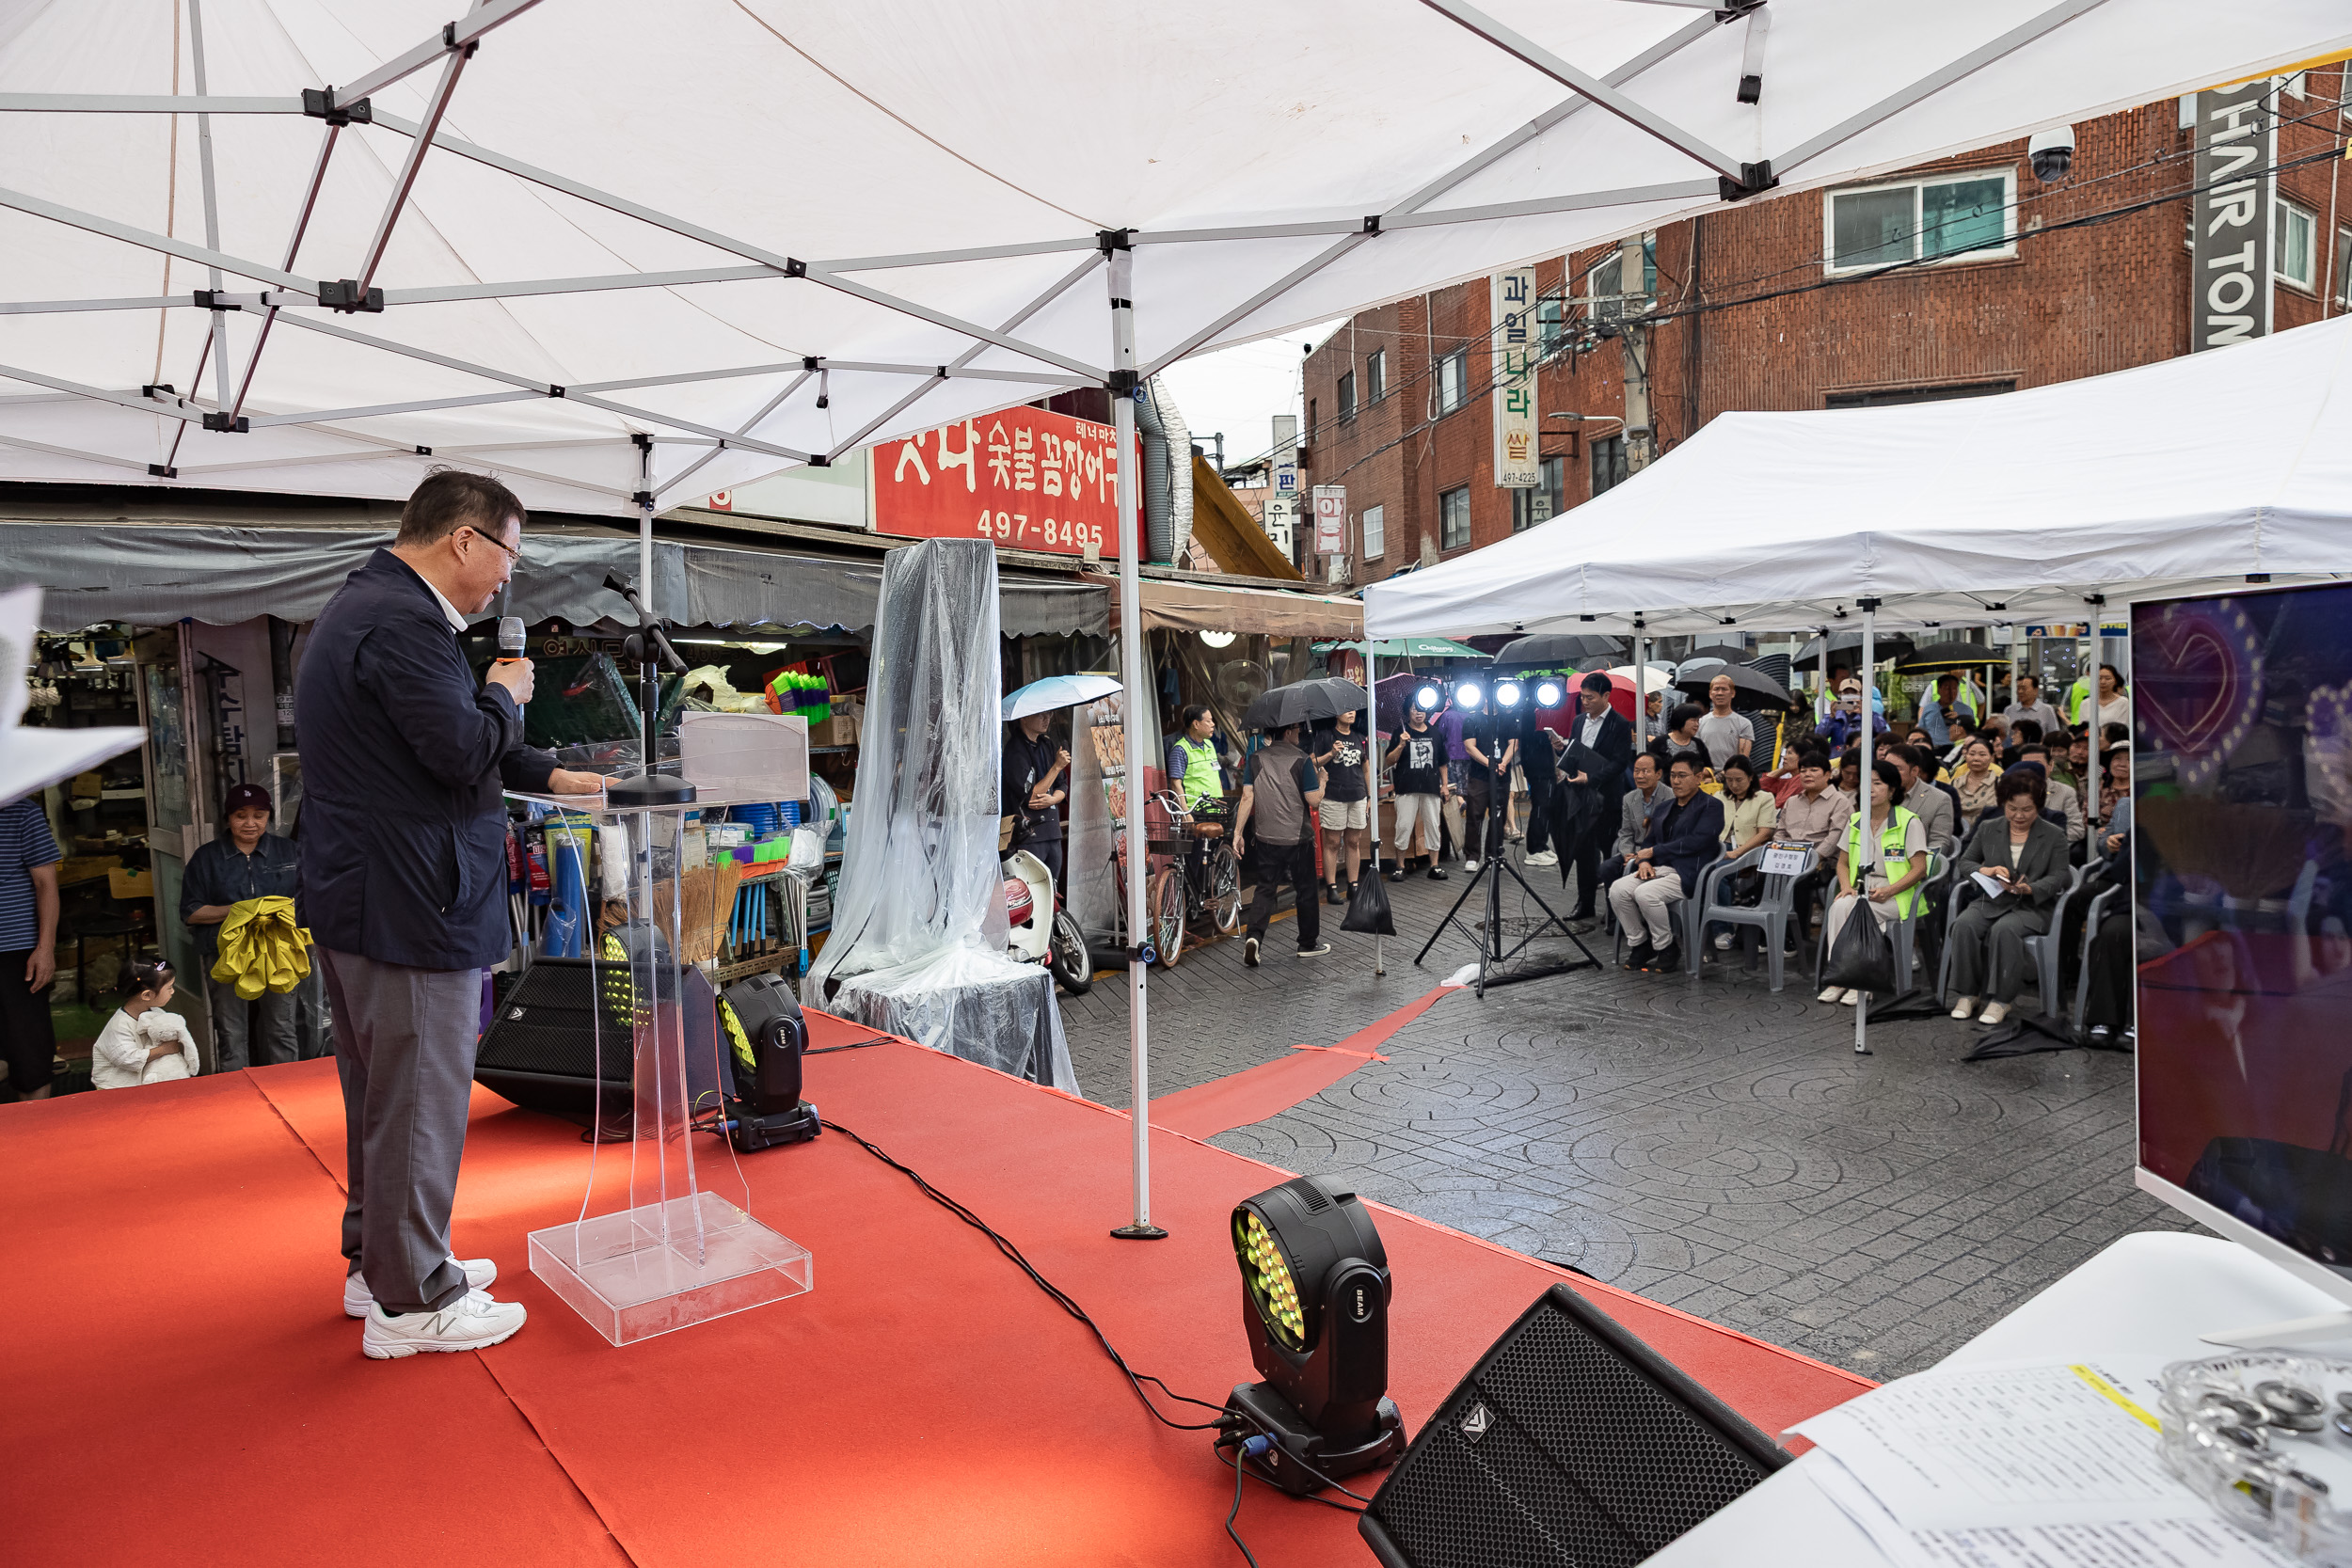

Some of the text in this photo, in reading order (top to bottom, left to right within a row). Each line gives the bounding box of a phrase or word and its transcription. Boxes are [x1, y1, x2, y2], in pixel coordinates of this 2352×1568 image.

[2208, 99, 2258, 238] HAIR
[1507, 434, 1530, 460] 쌀
[1502, 472, 1535, 483] 497-4225
[977, 509, 1104, 549] 497-8495
[1356, 1289, 1364, 1316] BEAM
